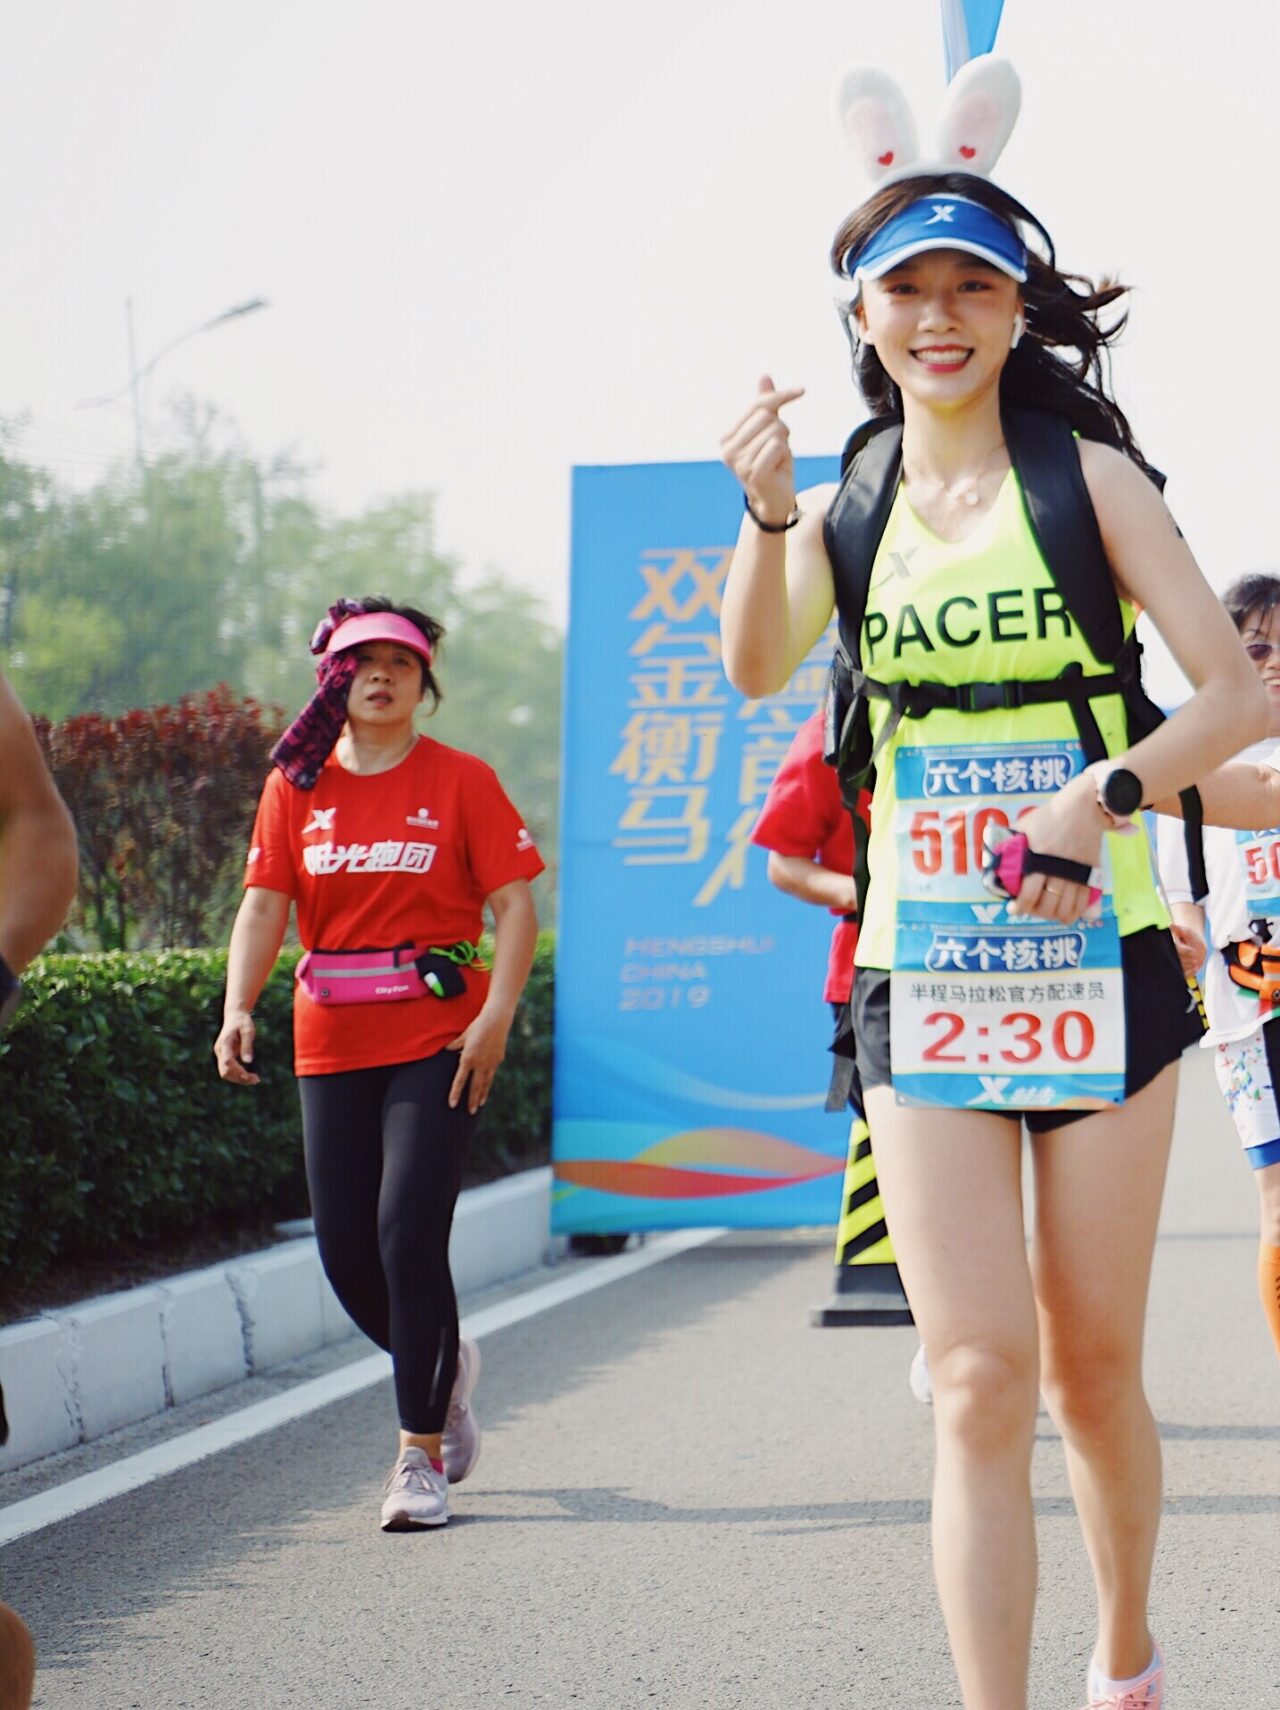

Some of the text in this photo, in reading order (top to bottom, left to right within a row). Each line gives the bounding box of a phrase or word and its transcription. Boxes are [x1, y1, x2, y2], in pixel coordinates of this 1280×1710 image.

[864, 587, 1072, 665] PACER
[928, 757, 1067, 795] 六个核桃
[910, 806, 1037, 876] 510
[934, 938, 1080, 971] 六个核桃
[618, 985, 710, 1012] 2019
[910, 981, 1106, 1004] 半程马拉松官方配速员
[922, 1009, 1095, 1065] 2:30
